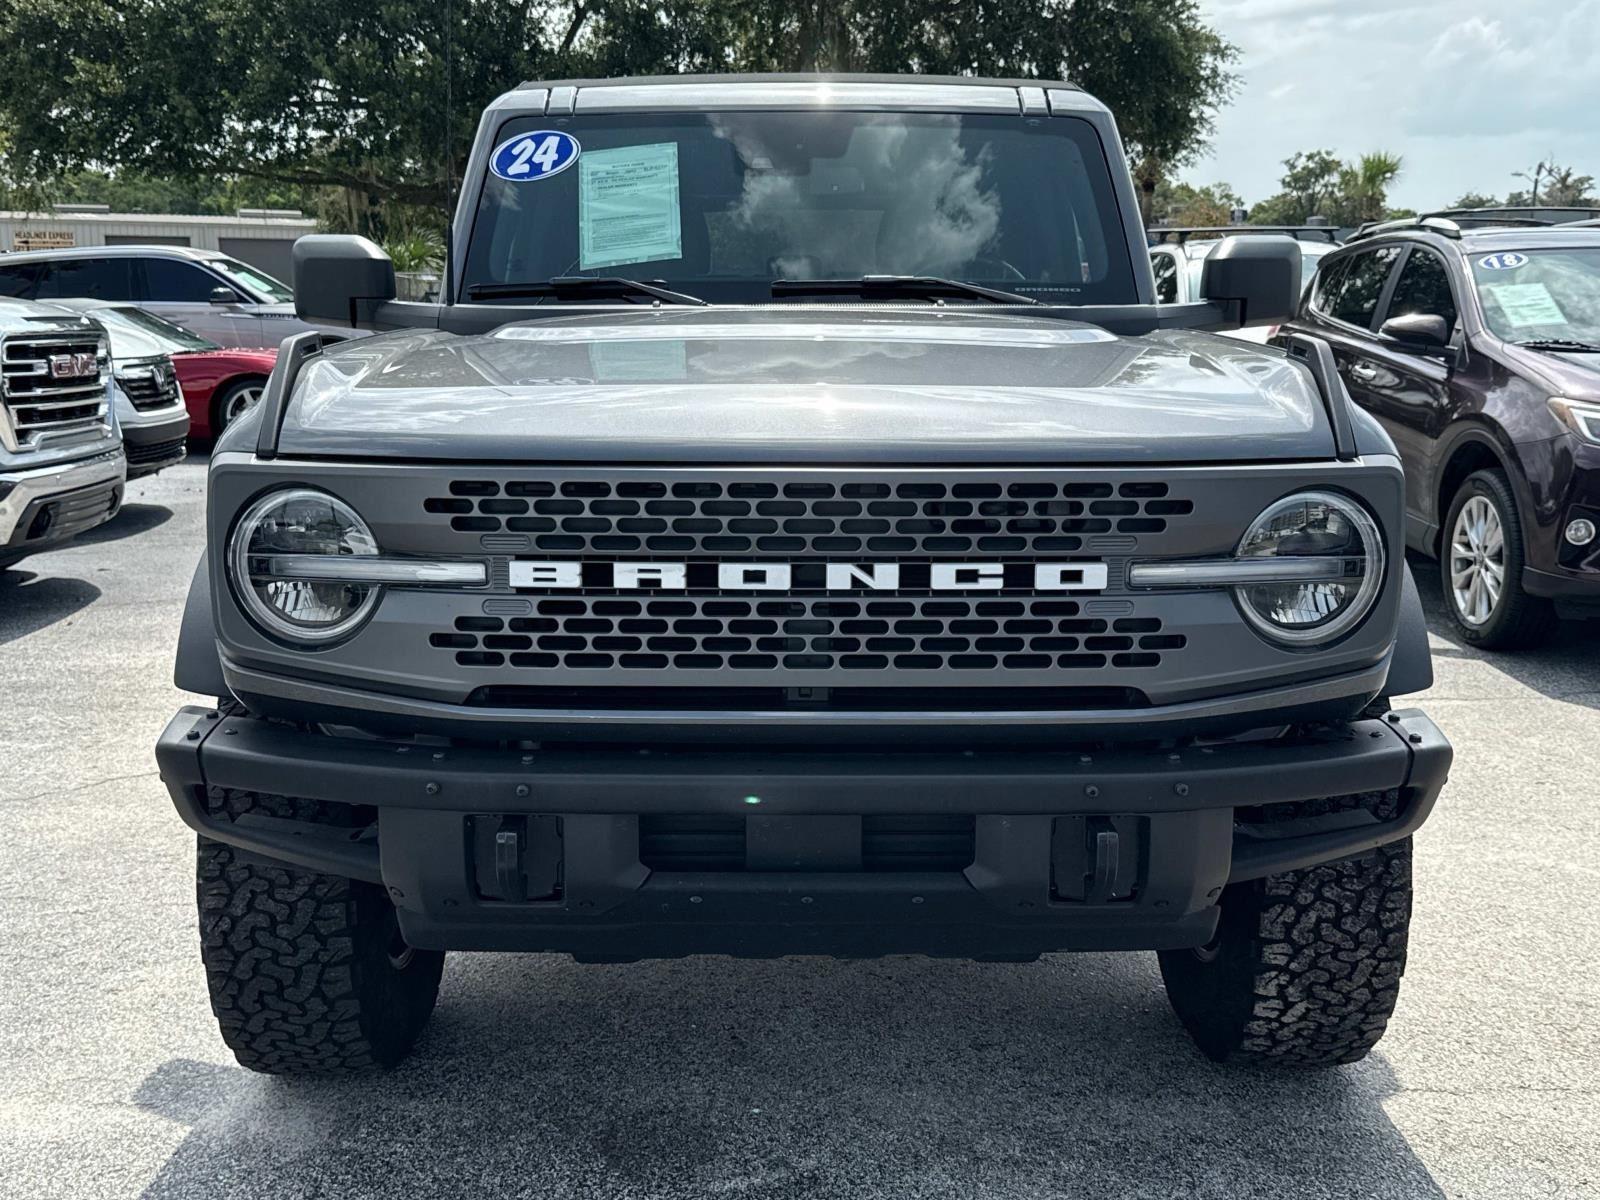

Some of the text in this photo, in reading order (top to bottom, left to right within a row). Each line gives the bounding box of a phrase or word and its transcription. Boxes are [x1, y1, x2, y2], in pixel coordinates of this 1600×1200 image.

[507, 135, 560, 176] 24
[48, 231, 74, 240] EXPRESS
[1488, 253, 1518, 269] 18
[50, 353, 98, 378] GMC
[508, 560, 1109, 590] BRONCO
